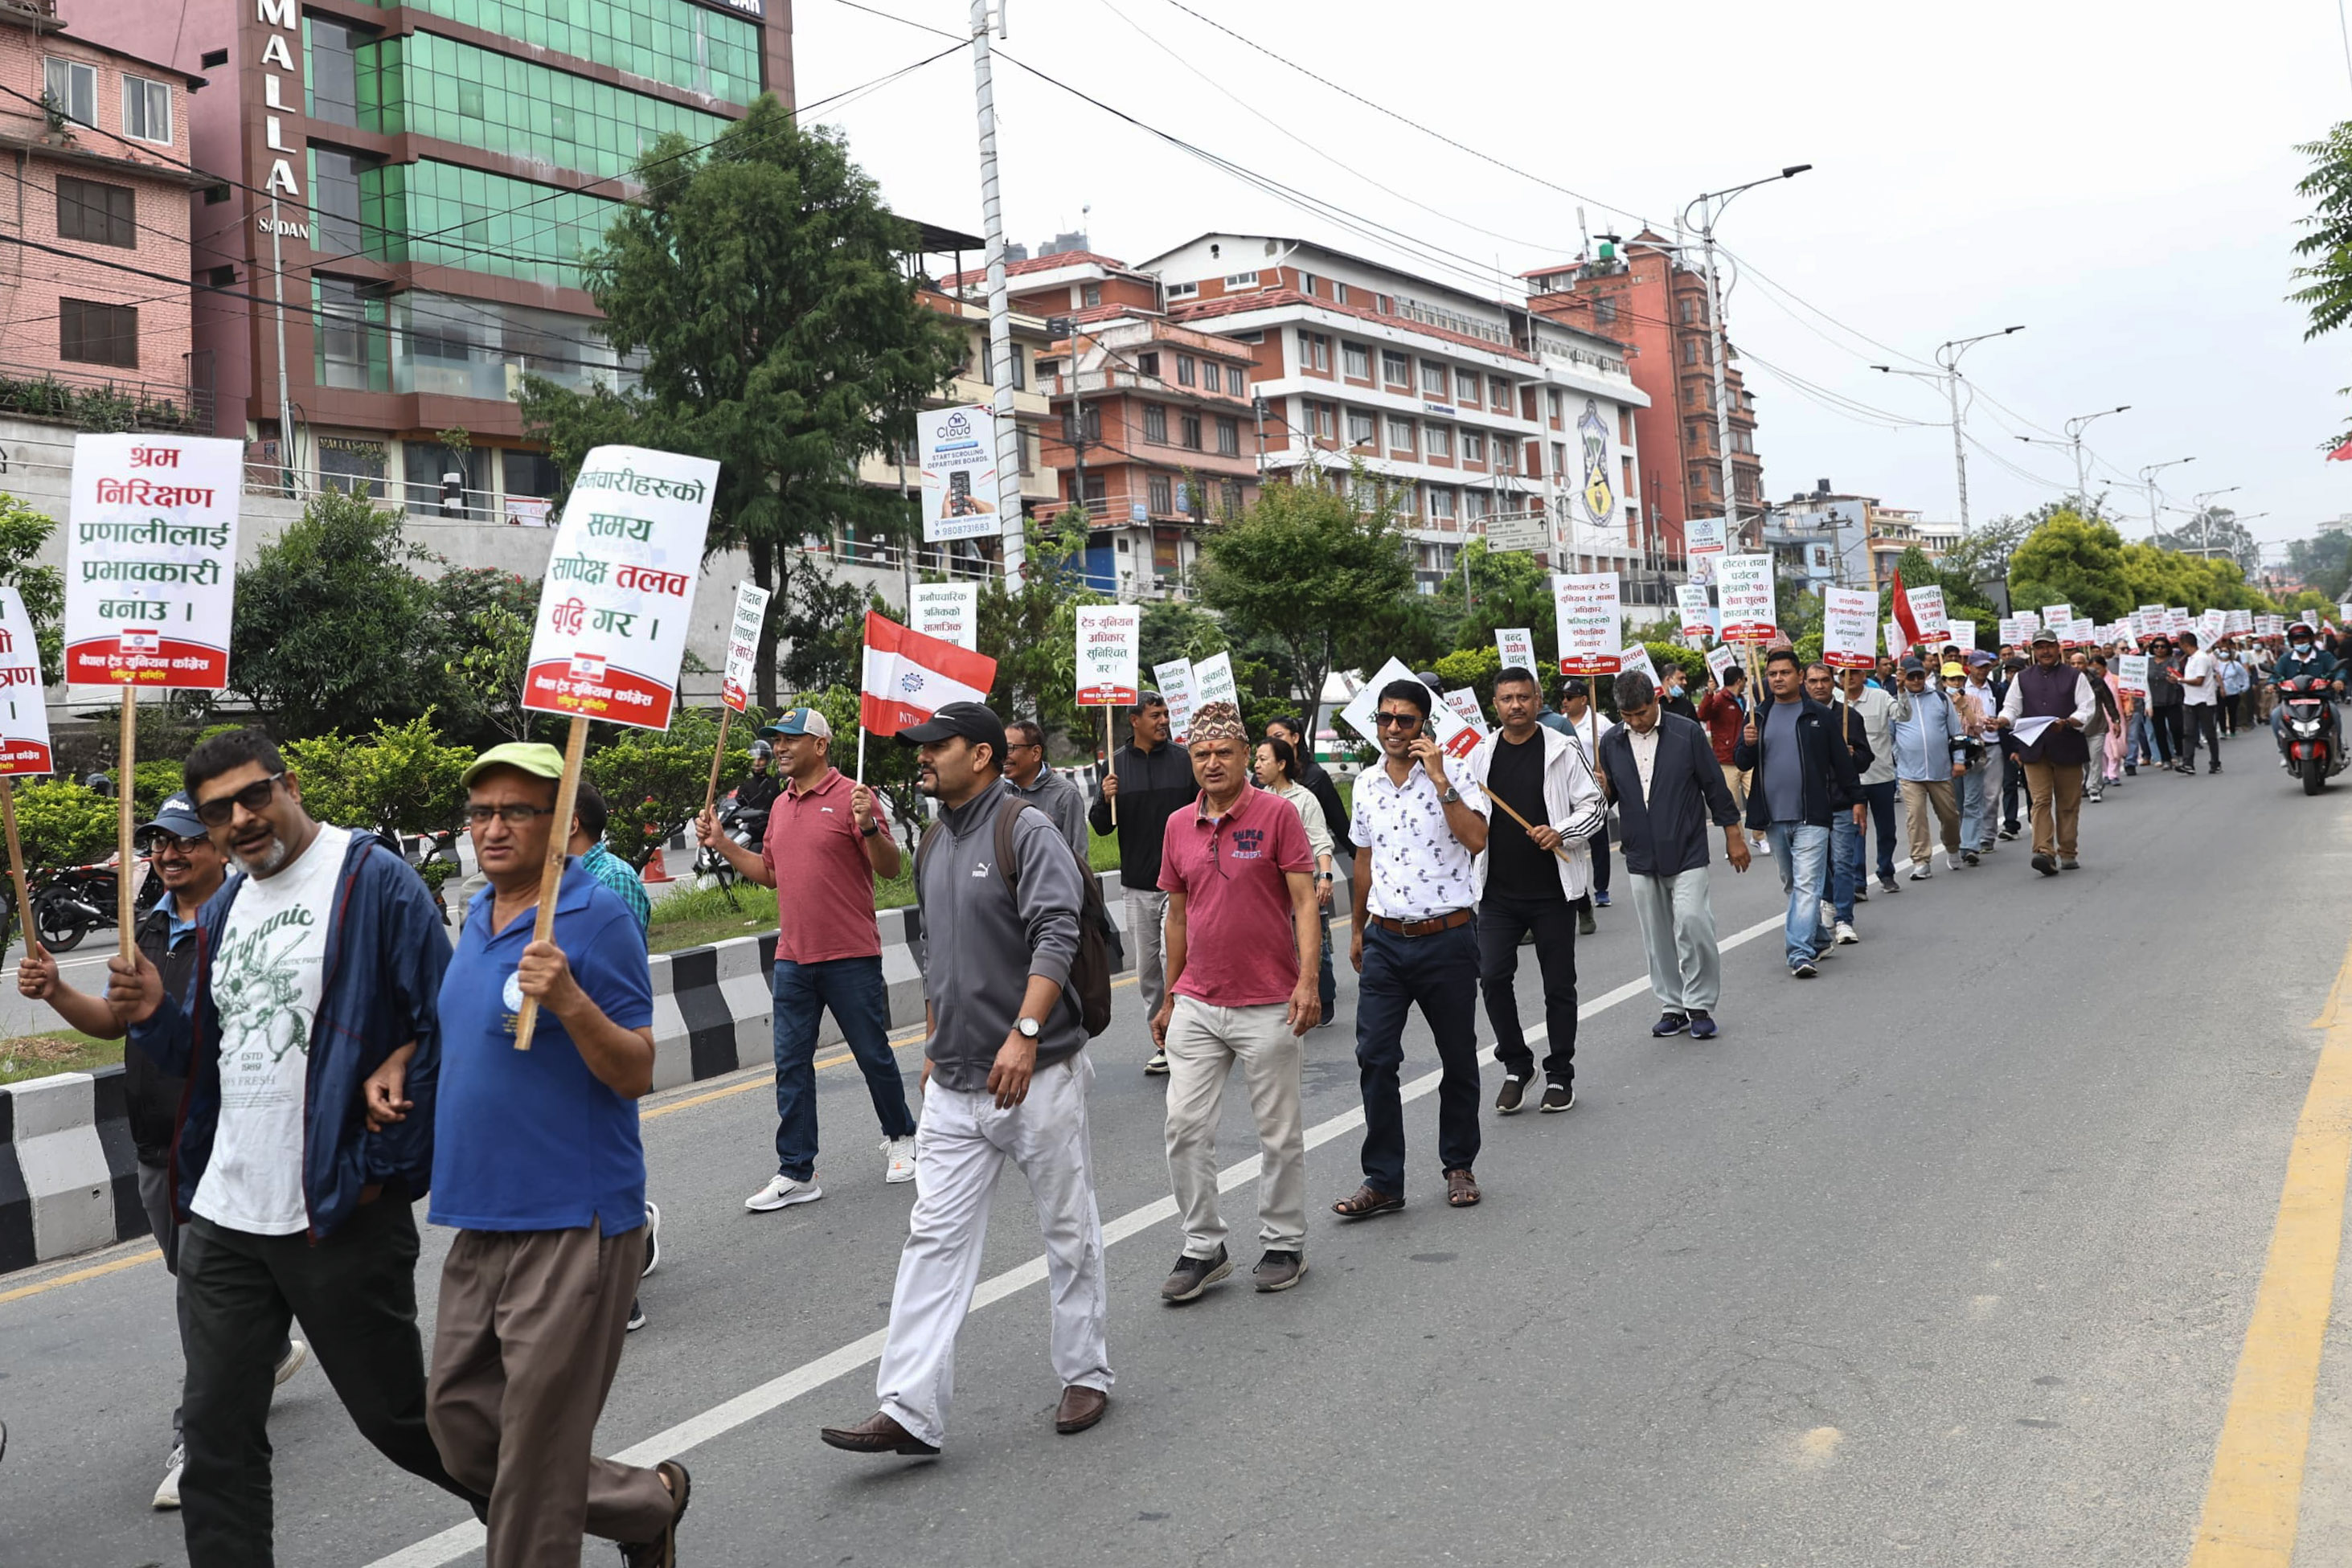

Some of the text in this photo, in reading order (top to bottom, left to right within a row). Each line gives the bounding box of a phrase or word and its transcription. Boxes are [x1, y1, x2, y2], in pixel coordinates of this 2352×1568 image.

[256, 0, 299, 195] MALLA
[937, 423, 970, 438] Cloud
[129, 447, 182, 469] श्रम
[928, 458, 961, 469] DEPARTURE
[932, 448, 984, 461] START SCROLLING
[96, 477, 215, 508] निरिक्षण
[79, 518, 232, 551] प्रणालीलाई
[587, 513, 654, 542] समय
[82, 559, 223, 586] प्रभावकारी
[551, 551, 609, 585] सापेक्ष
[1723, 559, 1746, 569] होटल
[98, 599, 171, 622] बनाउ
[552, 597, 588, 636] वृद्धि
[592, 608, 641, 638] गर
[924, 621, 961, 633] सामाजिक
[1088, 631, 1126, 643] अधिकार
[79, 653, 105, 666] नेपाल
[1096, 664, 1110, 673] गर
[211, 903, 315, 988] Organic
[241, 1052, 264, 1060] ESTD
